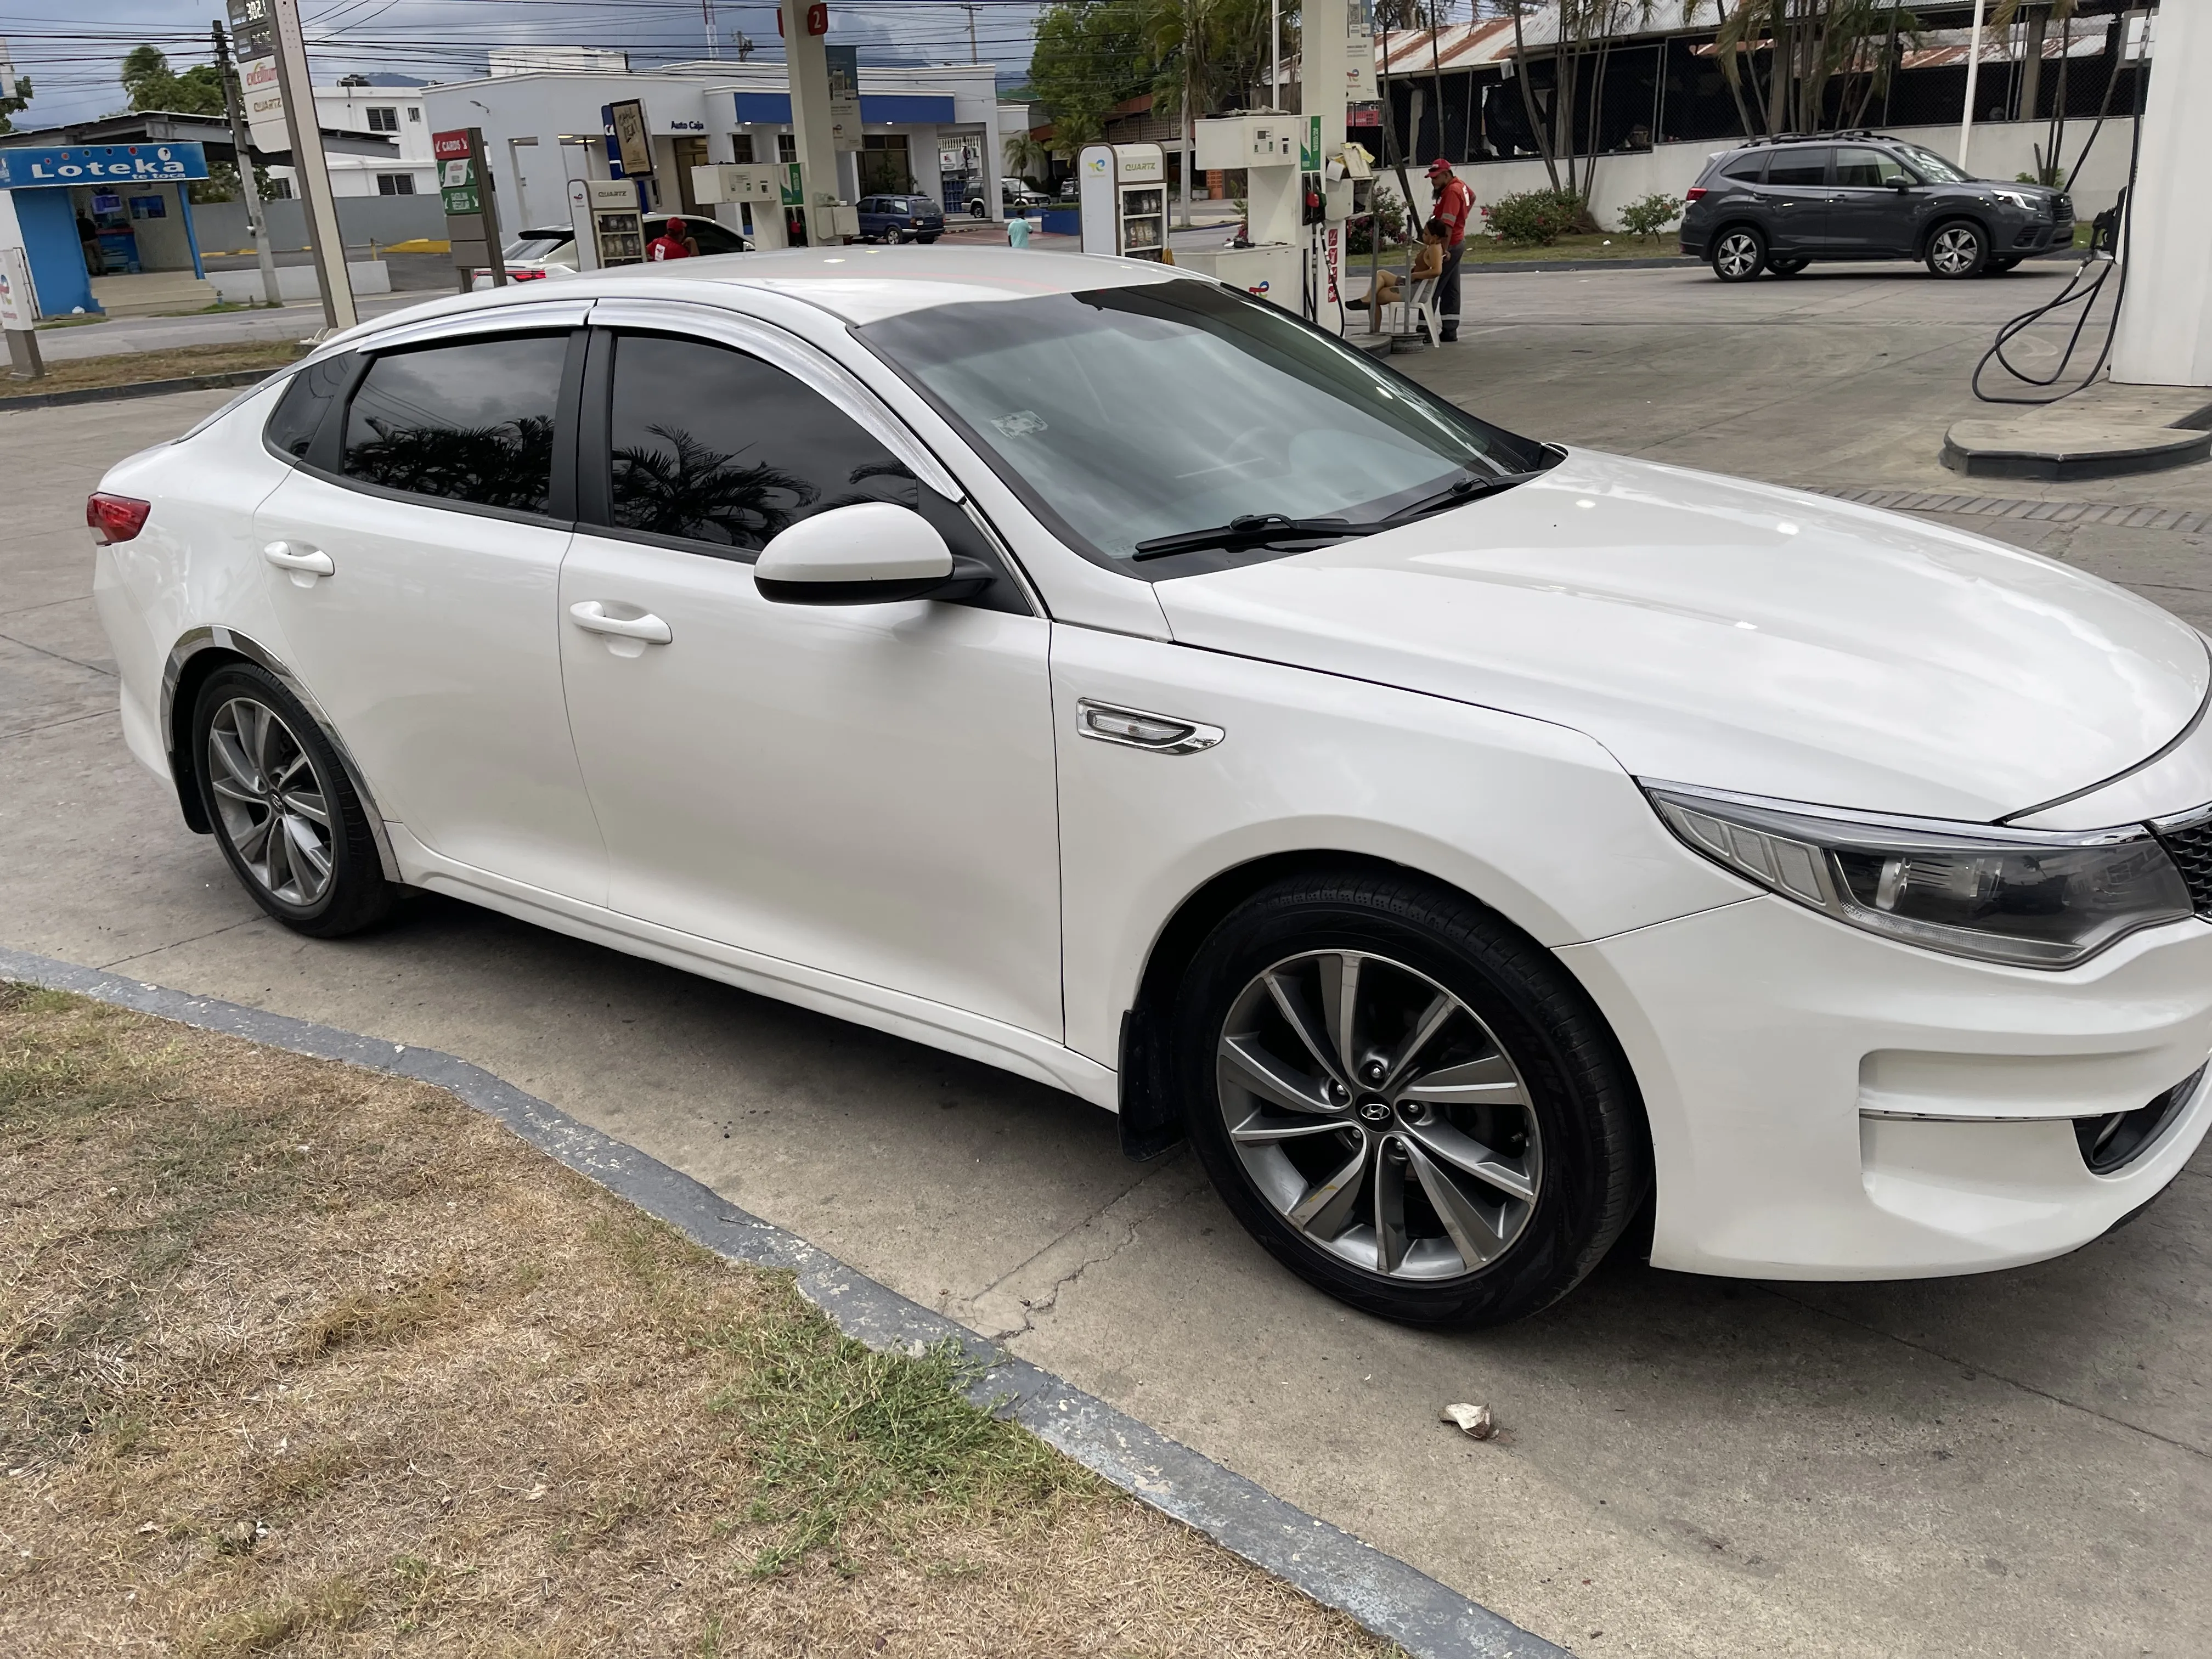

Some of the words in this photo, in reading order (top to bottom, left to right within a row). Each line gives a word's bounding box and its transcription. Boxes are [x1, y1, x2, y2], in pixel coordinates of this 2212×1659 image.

[813, 11, 821, 29] 2
[671, 121, 687, 129] Auto
[689, 121, 704, 132] Caja
[31, 159, 185, 178] Loteka
[1125, 162, 1155, 171] QUARTZ
